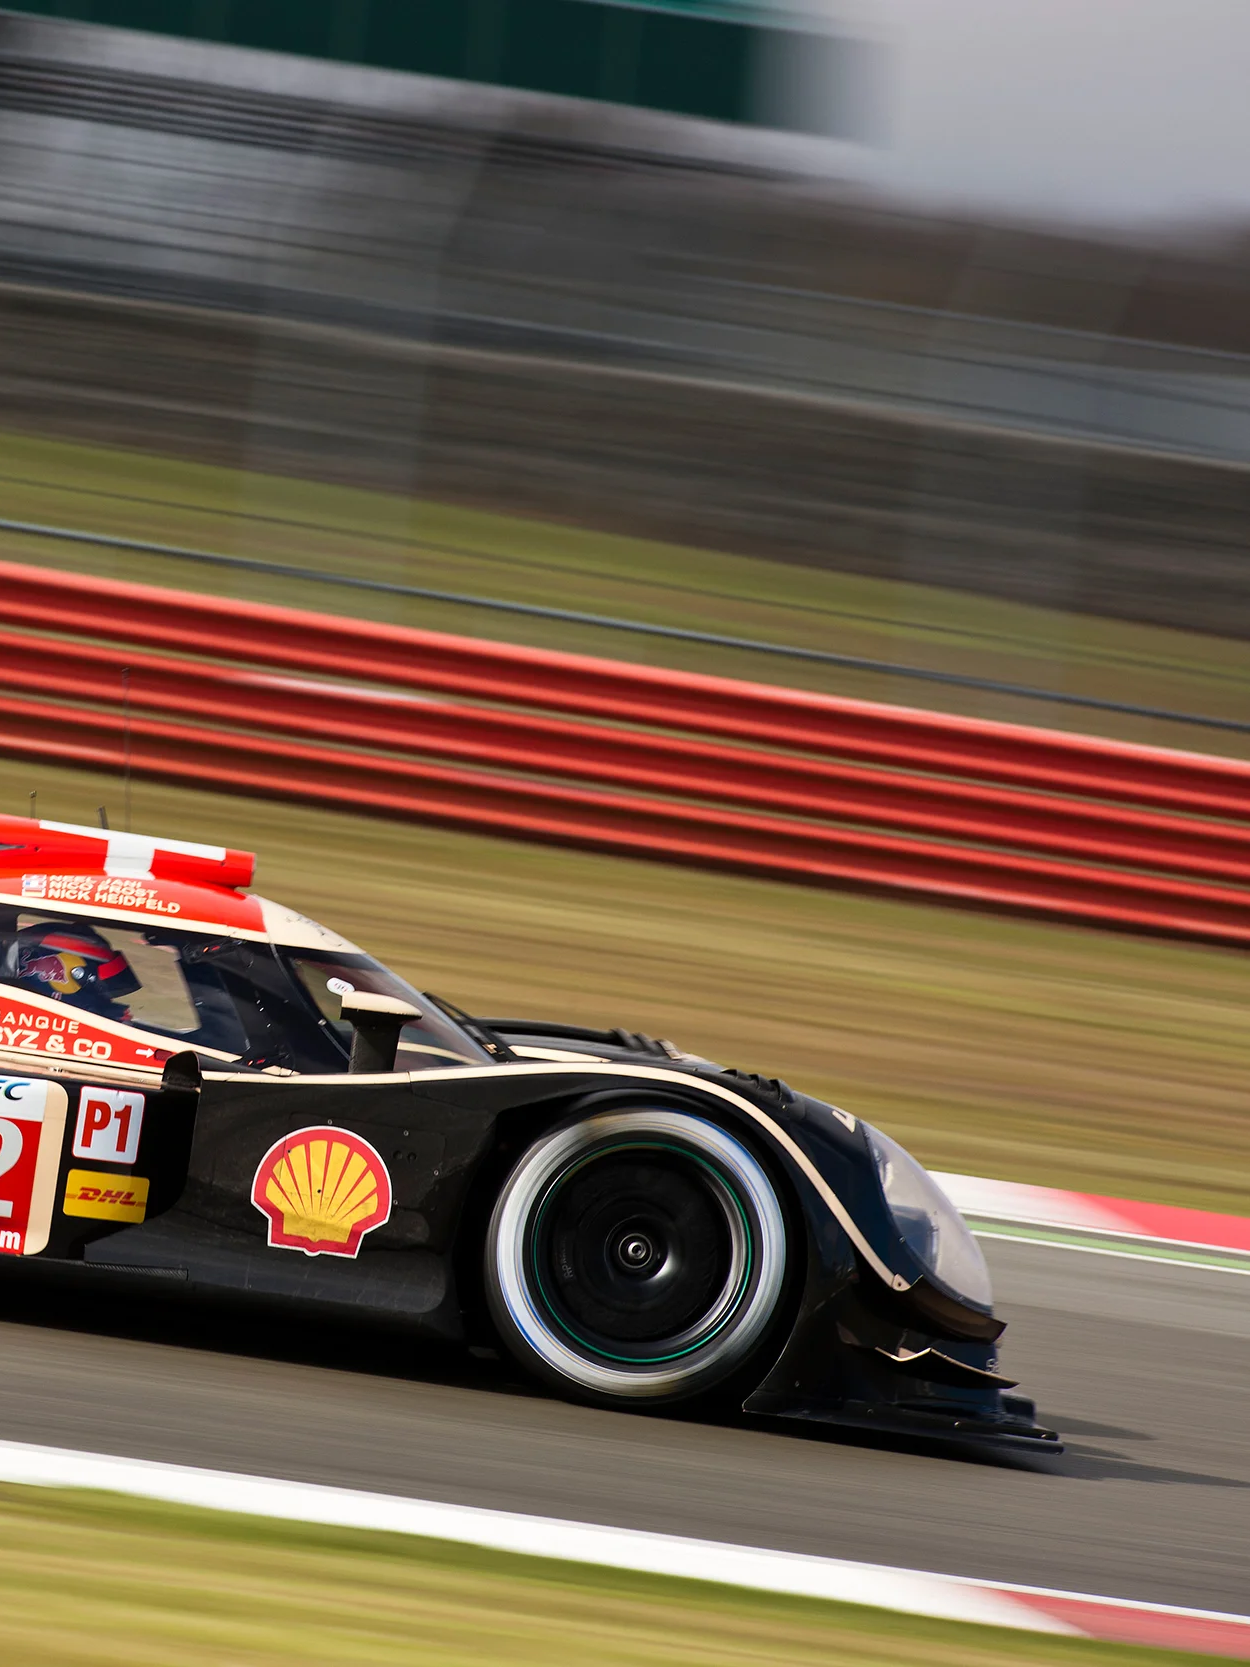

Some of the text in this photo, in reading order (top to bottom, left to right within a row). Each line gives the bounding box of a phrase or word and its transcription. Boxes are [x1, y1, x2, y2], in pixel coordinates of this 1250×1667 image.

[49, 880, 95, 891] NICO
[48, 888, 181, 914] NICK HEIDFELD
[45, 1034, 66, 1053] &
[73, 1038, 112, 1060] CO
[80, 1099, 133, 1153] P1
[77, 1187, 139, 1206] DHL
